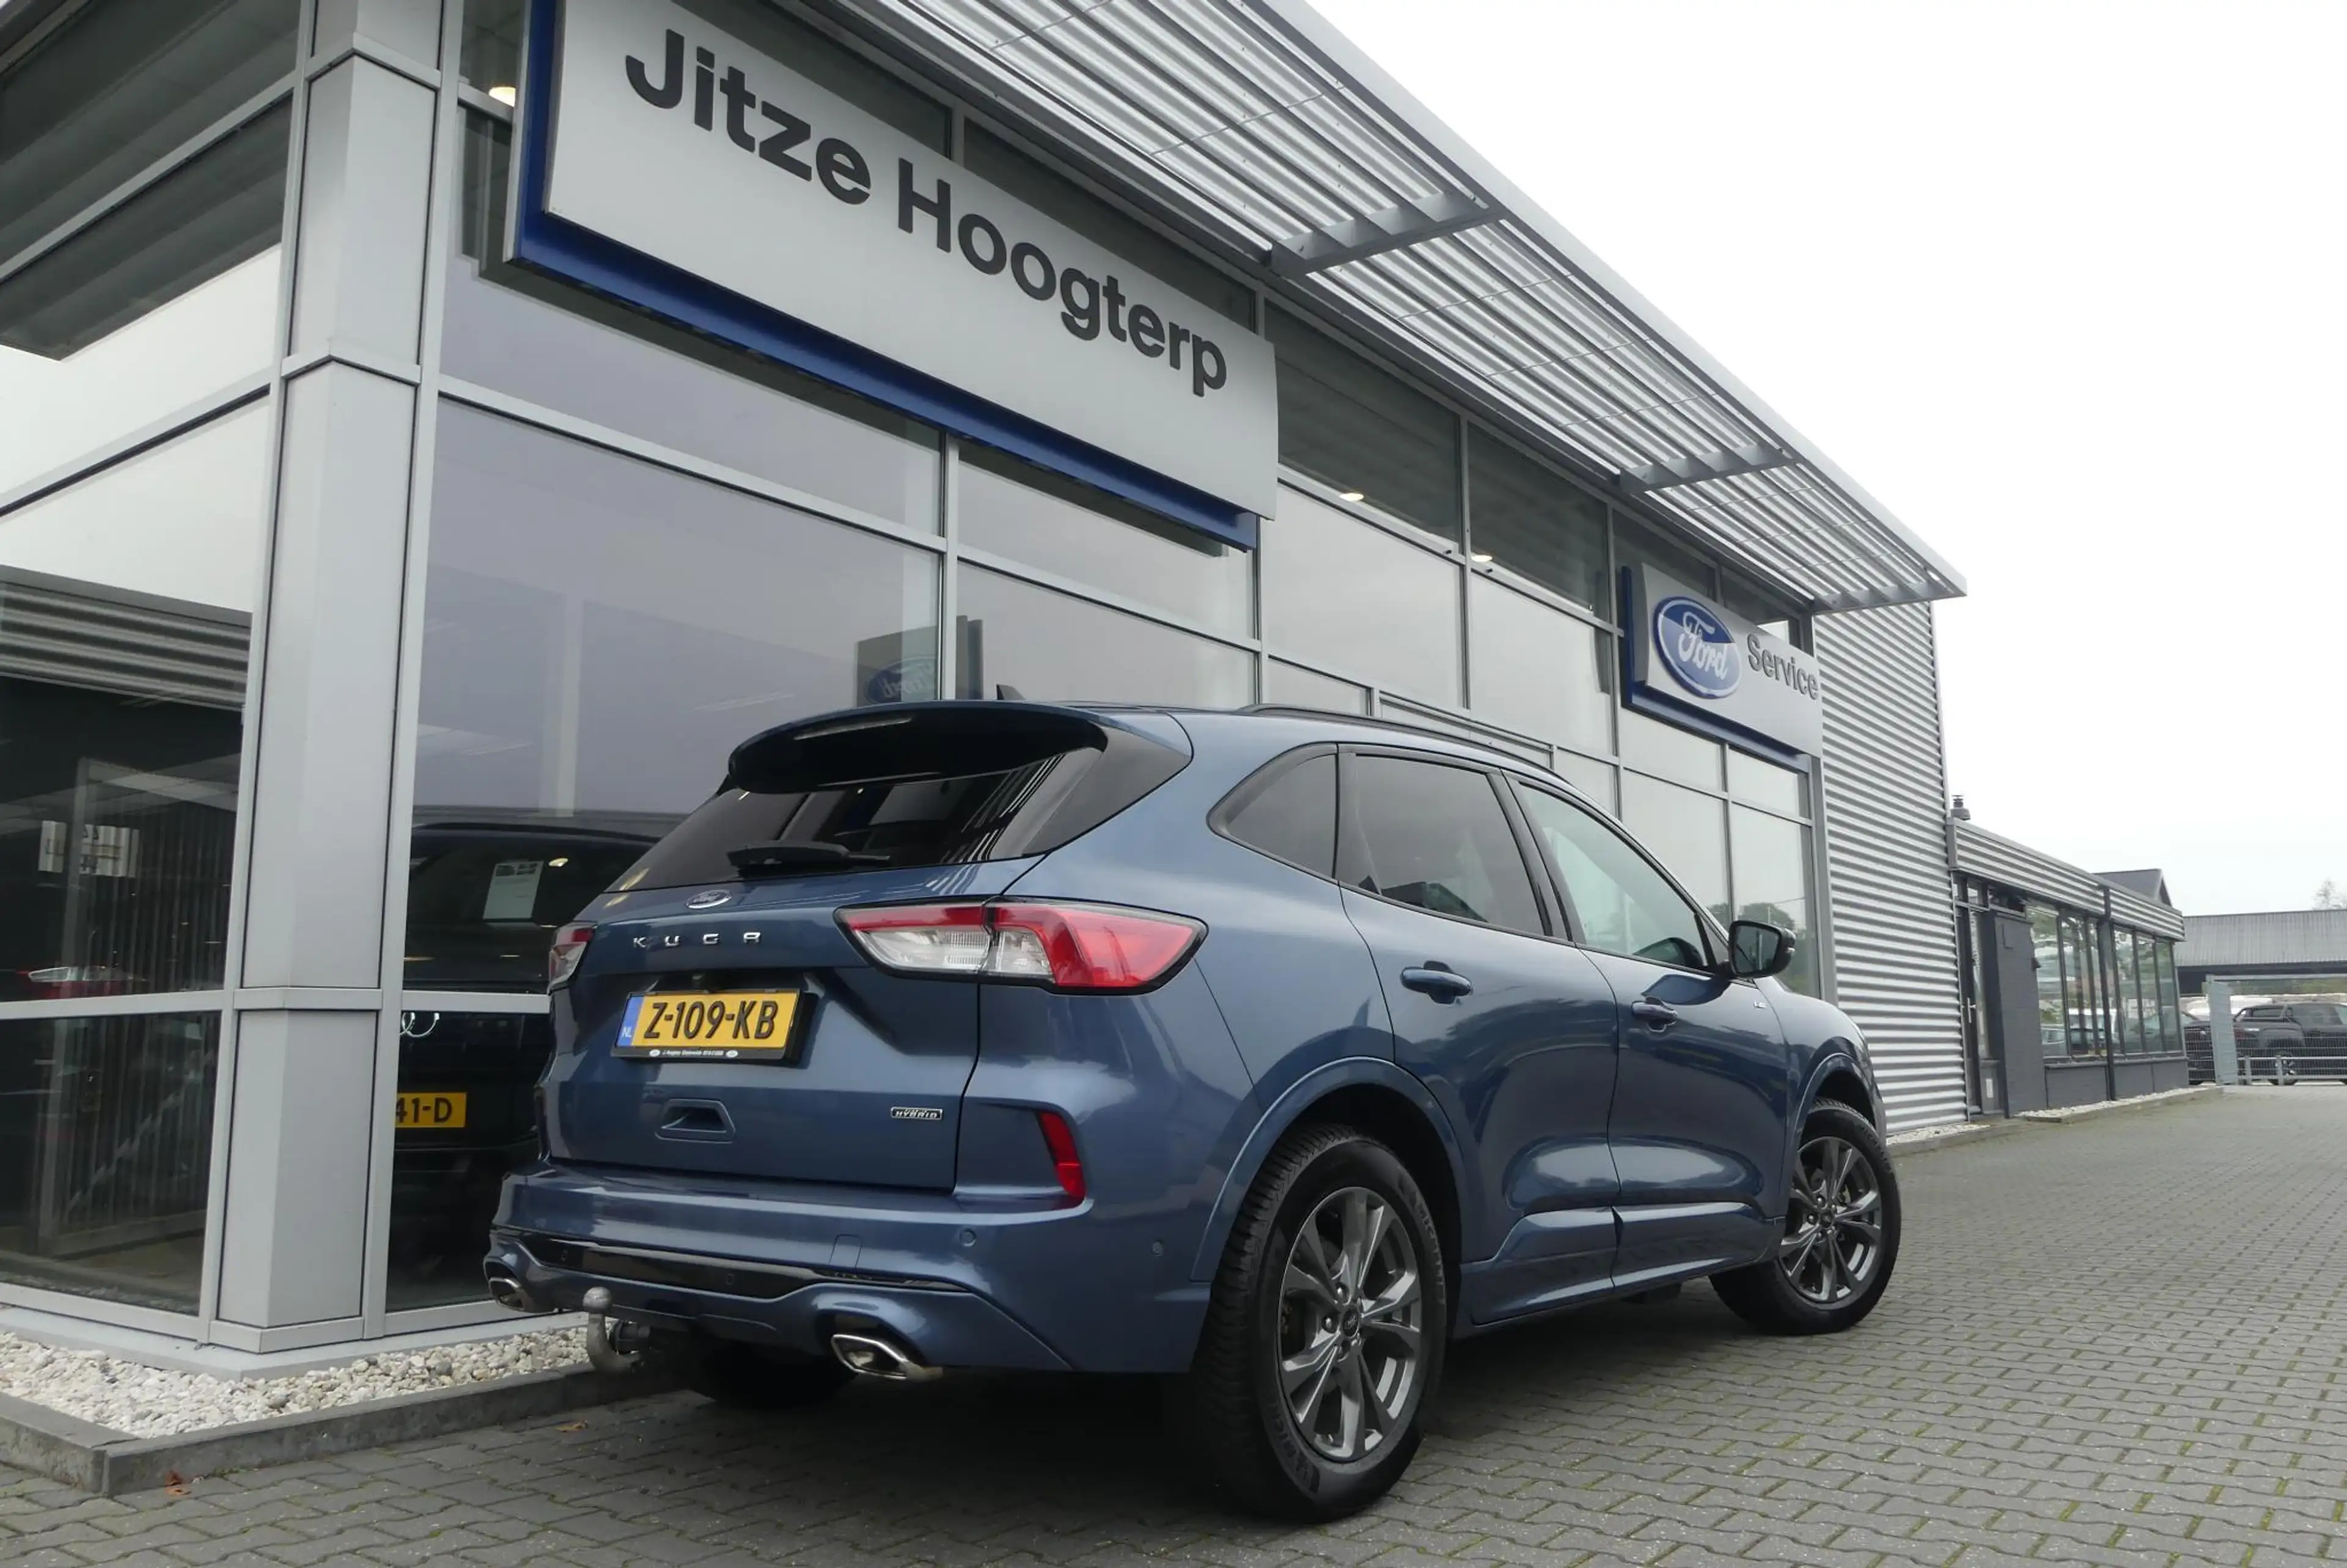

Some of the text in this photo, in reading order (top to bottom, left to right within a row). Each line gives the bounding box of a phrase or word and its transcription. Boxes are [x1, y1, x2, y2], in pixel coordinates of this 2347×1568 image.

[625, 28, 1227, 398] Jitze Hoogterp
[1678, 611, 1820, 700] Ford Service
[633, 931, 762, 948] KUGA
[622, 1026, 632, 1038] NL
[643, 1000, 779, 1039] Z-109-KB
